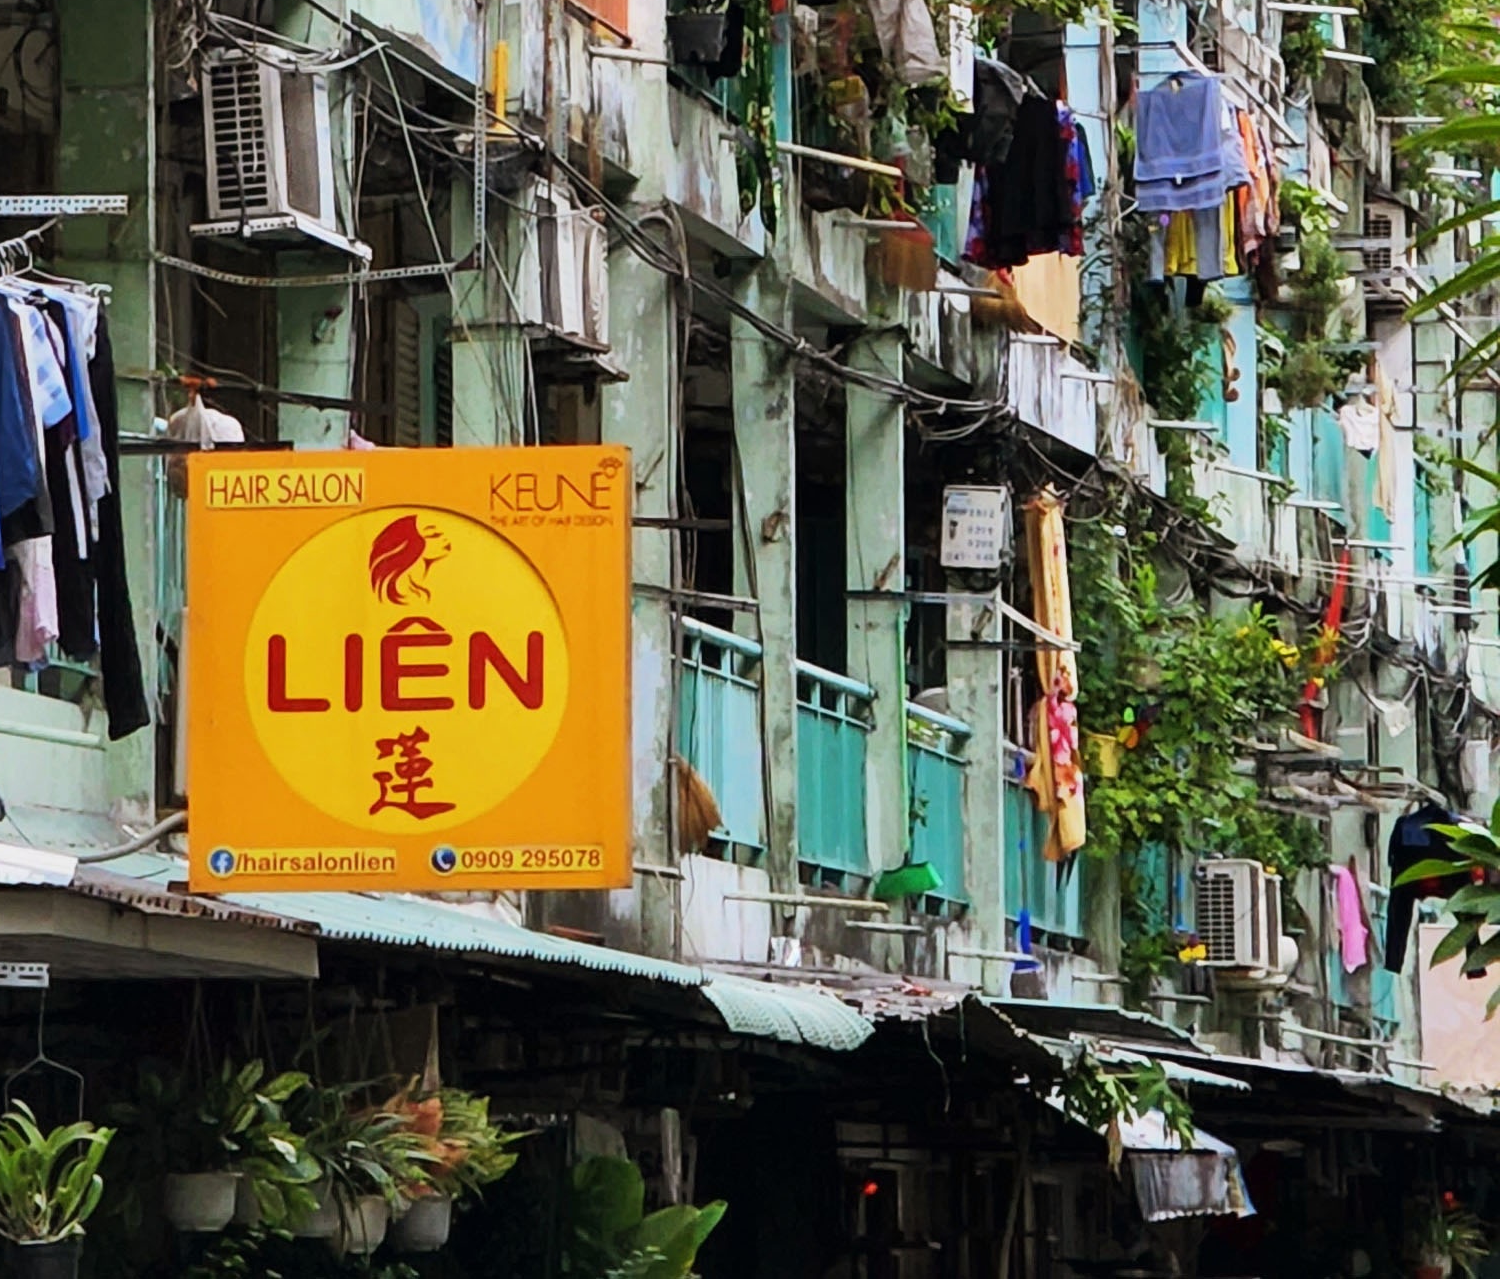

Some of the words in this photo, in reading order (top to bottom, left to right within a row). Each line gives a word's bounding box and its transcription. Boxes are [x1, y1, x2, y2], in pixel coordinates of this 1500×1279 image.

[209, 475, 270, 505] HAIR
[277, 473, 363, 503] SALON
[490, 471, 611, 512] KEUNE
[268, 616, 544, 712] LIÊN
[369, 725, 456, 820] 蓮
[461, 850, 514, 869] 0909
[521, 849, 600, 867] 295078
